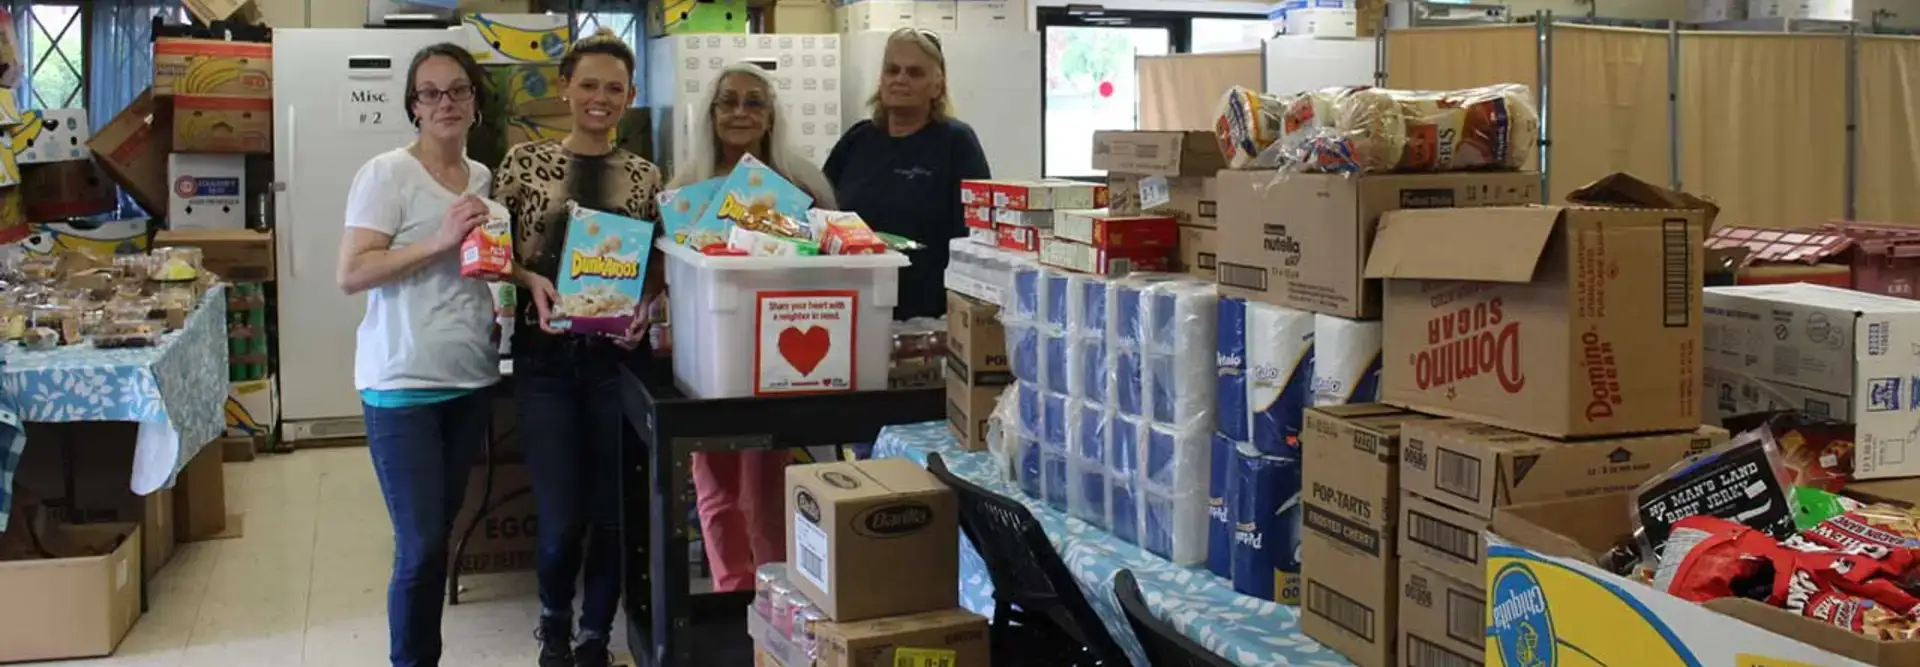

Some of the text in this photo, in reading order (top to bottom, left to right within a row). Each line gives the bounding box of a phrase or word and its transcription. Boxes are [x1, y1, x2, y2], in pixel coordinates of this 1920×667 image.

[351, 91, 389, 103] Misc.
[360, 111, 382, 125] # 2
[1263, 236, 1301, 253] nutella
[769, 301, 845, 311] Share your heart with
[779, 312, 810, 322] neighbor
[1428, 296, 1504, 345] SUGAR
[1720, 462, 1759, 486] LAND
[1312, 481, 1371, 519] POP-TARTS
[1665, 481, 1749, 524] BEEF JERKY
